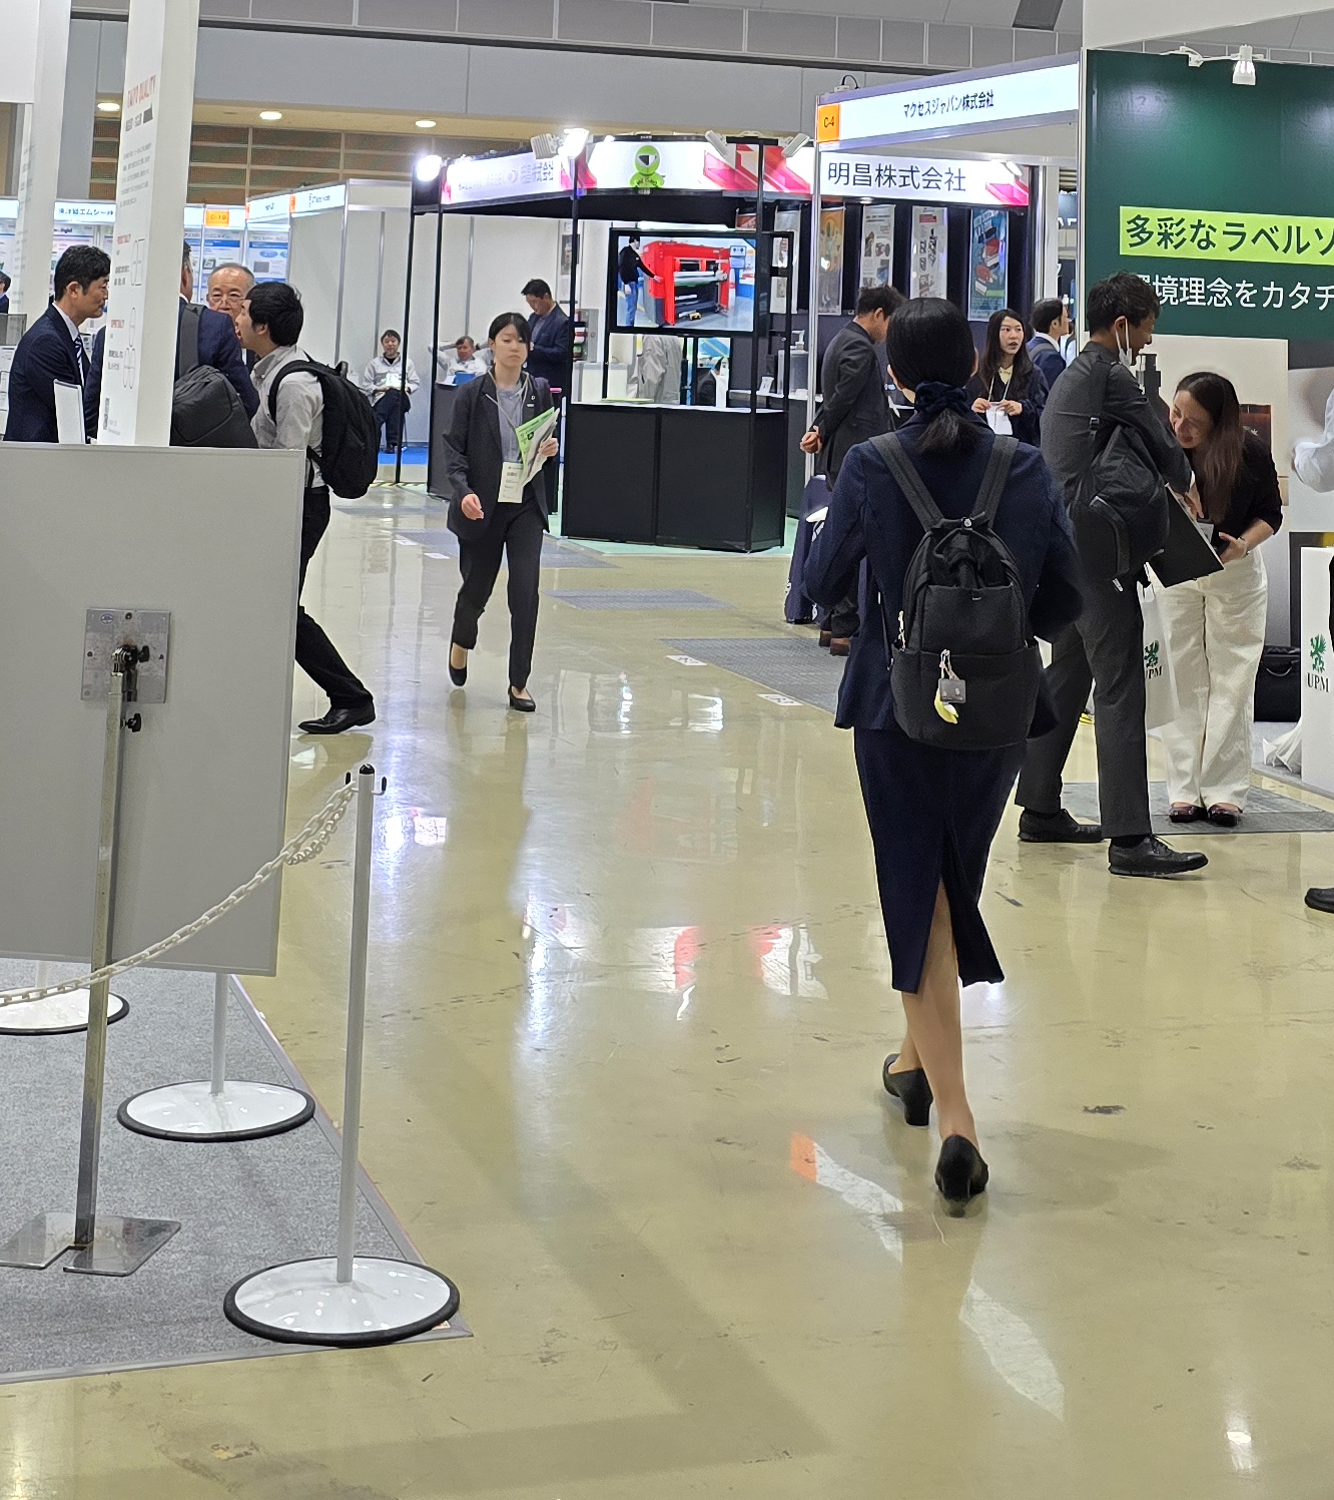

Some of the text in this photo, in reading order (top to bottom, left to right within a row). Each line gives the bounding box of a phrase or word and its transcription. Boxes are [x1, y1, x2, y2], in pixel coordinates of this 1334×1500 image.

[902, 88, 996, 119] マクセスジャパン株式会社
[823, 116, 836, 129] C-4
[827, 161, 967, 192] 明昌株式会社
[1306, 672, 1330, 693] UPM
